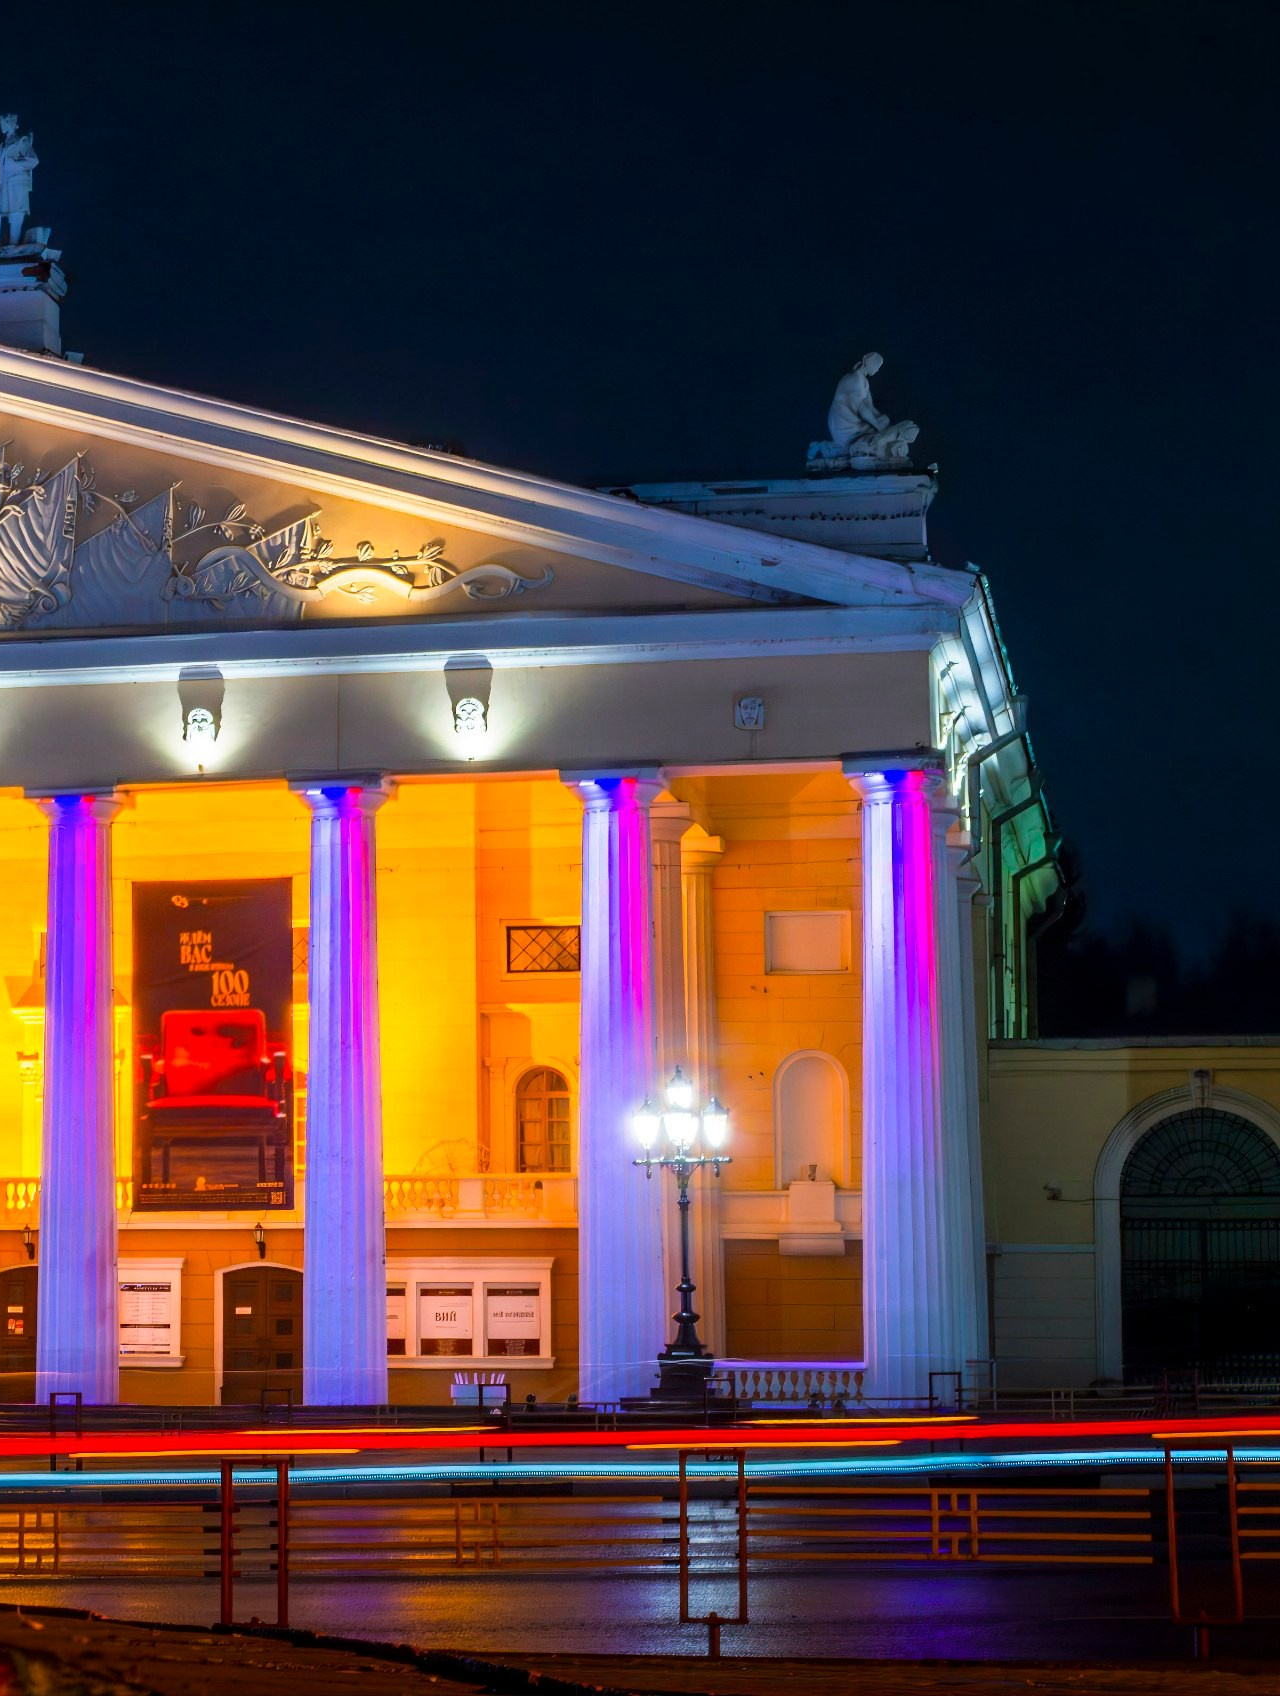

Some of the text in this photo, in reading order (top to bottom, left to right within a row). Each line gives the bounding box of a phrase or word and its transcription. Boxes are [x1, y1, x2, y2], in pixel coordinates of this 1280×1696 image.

[180, 944, 212, 964] ВАС
[211, 969, 249, 995] 100
[211, 993, 251, 1007] СЕЗОНЕ
